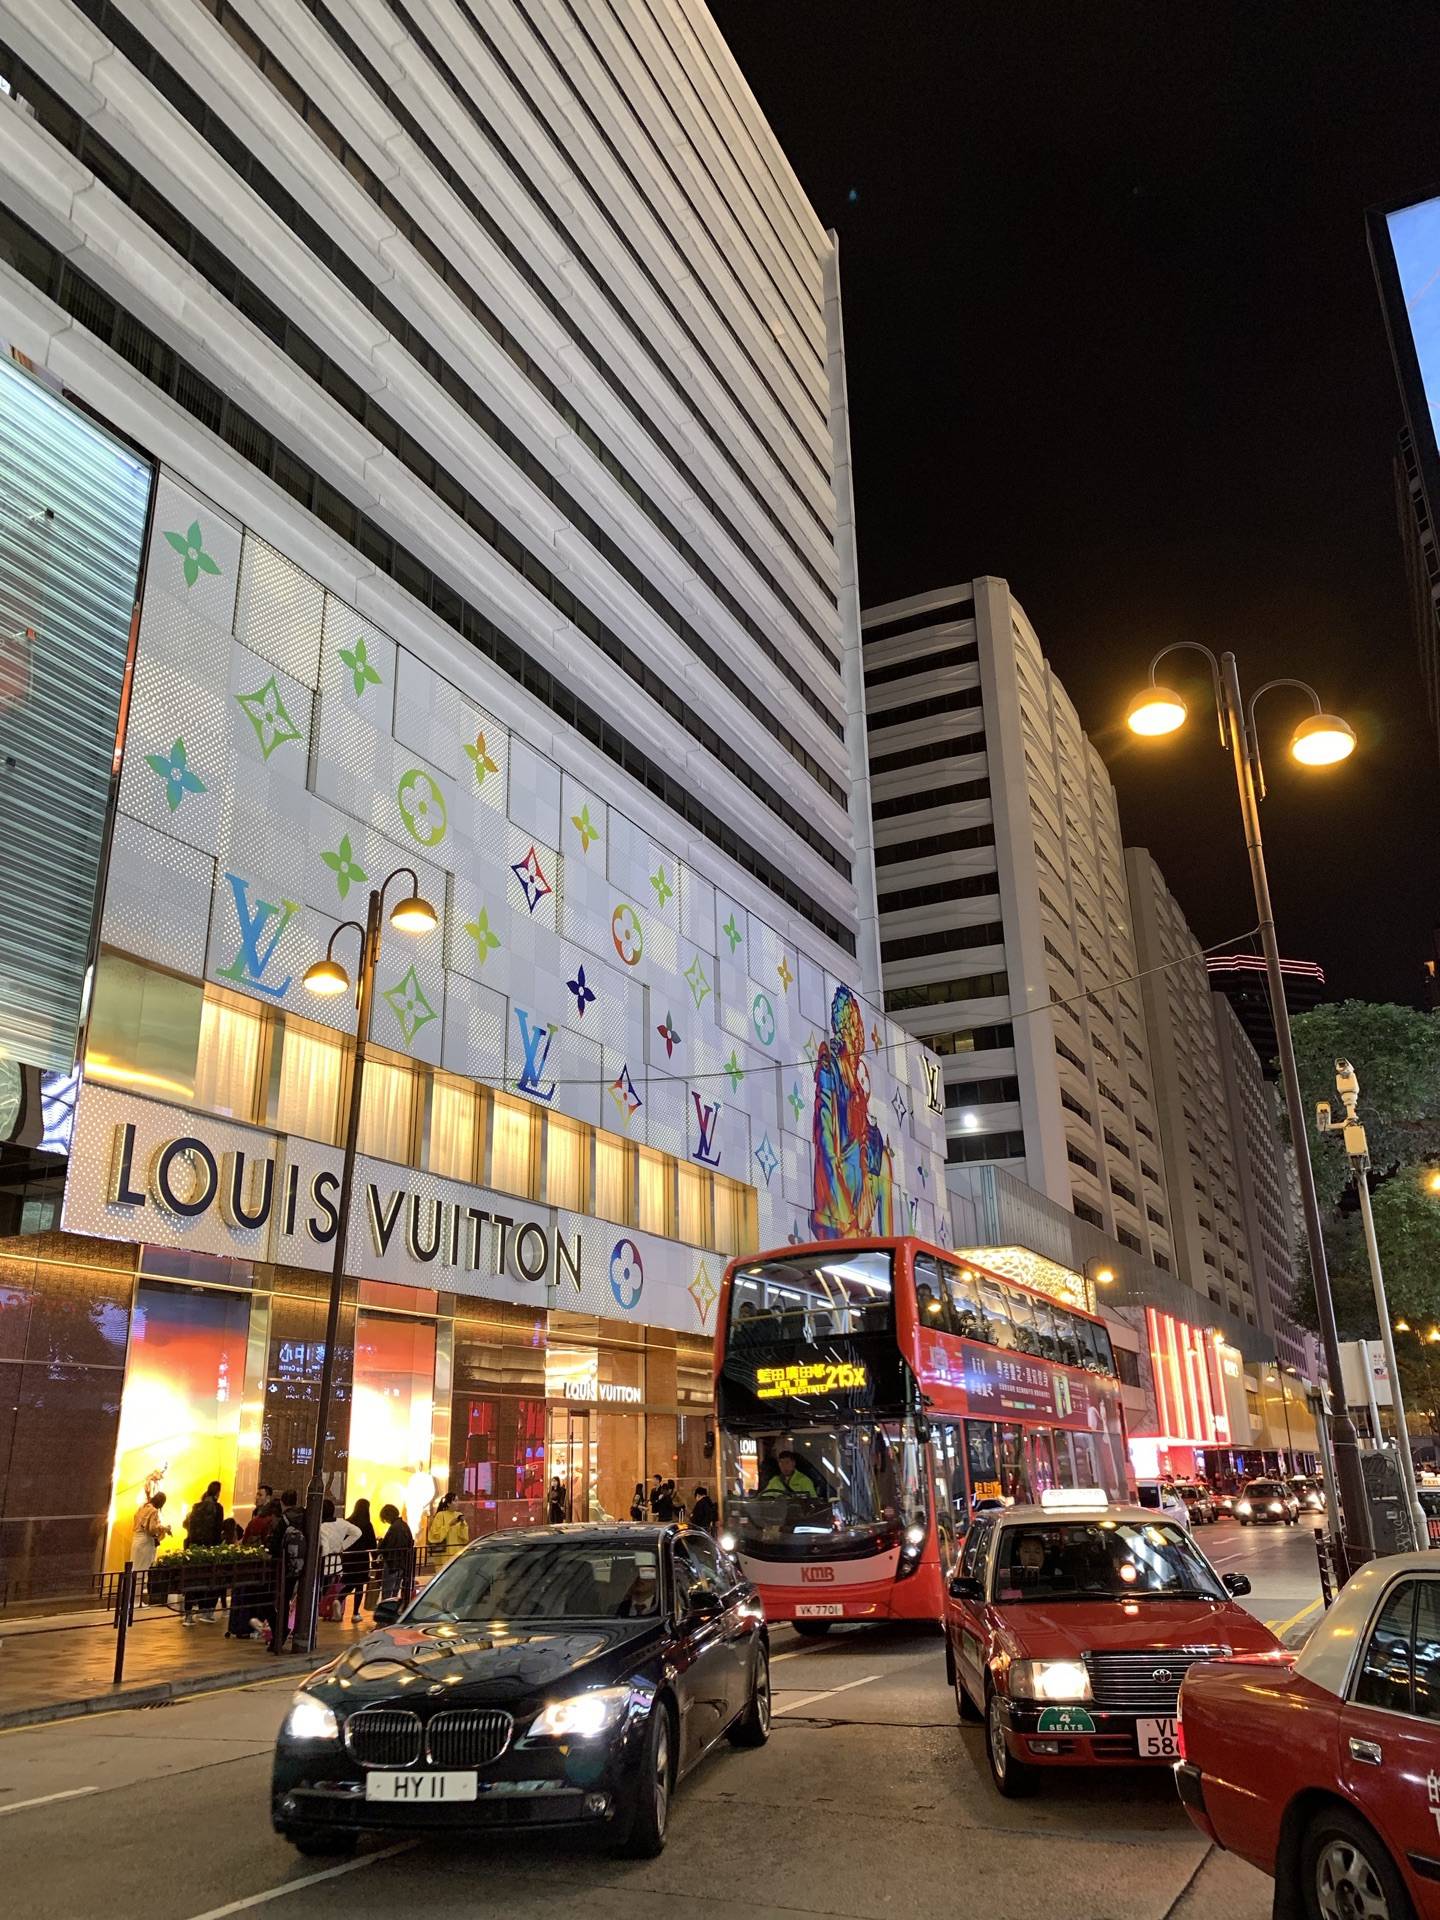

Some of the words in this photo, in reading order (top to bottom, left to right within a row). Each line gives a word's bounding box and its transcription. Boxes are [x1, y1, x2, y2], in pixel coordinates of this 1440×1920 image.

[215, 871, 302, 999] LV
[512, 1007, 559, 1101] LV
[691, 1091, 722, 1167] LV
[109, 1122, 341, 1243] LOUIS
[366, 1183, 583, 1294] VUITTON
[564, 1382, 597, 1401] LOUIS
[600, 1384, 641, 1403] VUITTON
[801, 1566, 835, 1583] KMB
[816, 1604, 838, 1615] 7701
[1059, 1713, 1071, 1724] 4
[394, 1775, 424, 1798] HY
